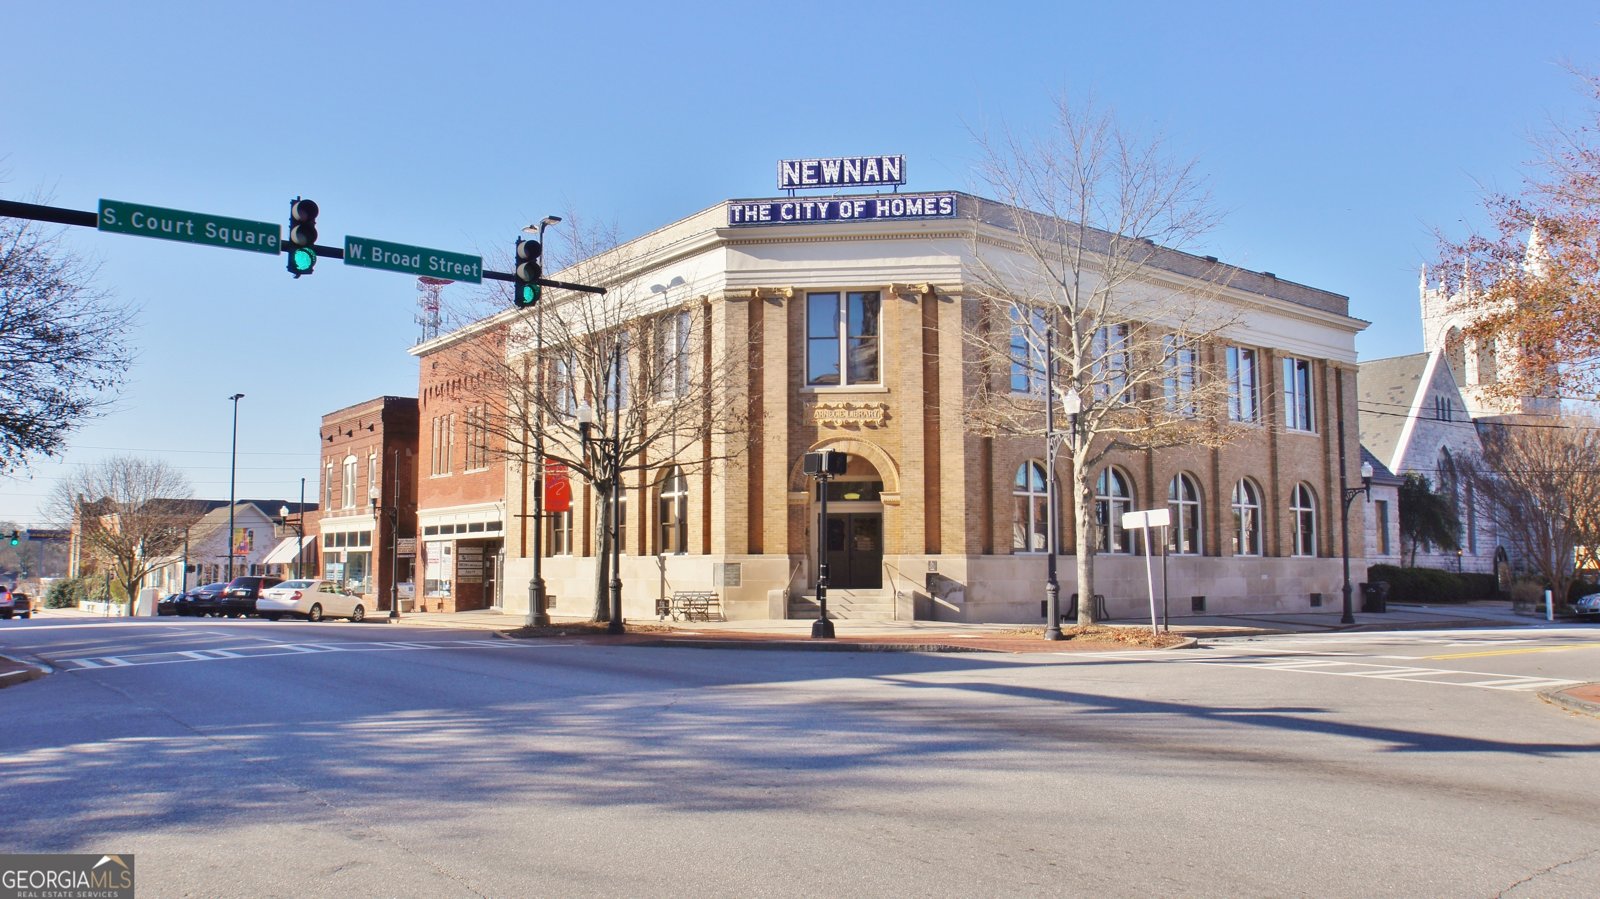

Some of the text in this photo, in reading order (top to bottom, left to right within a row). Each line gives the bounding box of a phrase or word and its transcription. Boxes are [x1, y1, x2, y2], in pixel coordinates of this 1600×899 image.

[782, 157, 901, 185] NEWNAN
[731, 197, 953, 222] THE CITY OF HOMES
[103, 207, 277, 247] S. Court Square
[349, 243, 478, 277] W. Broad Street
[847, 409, 880, 418] LIBRARY
